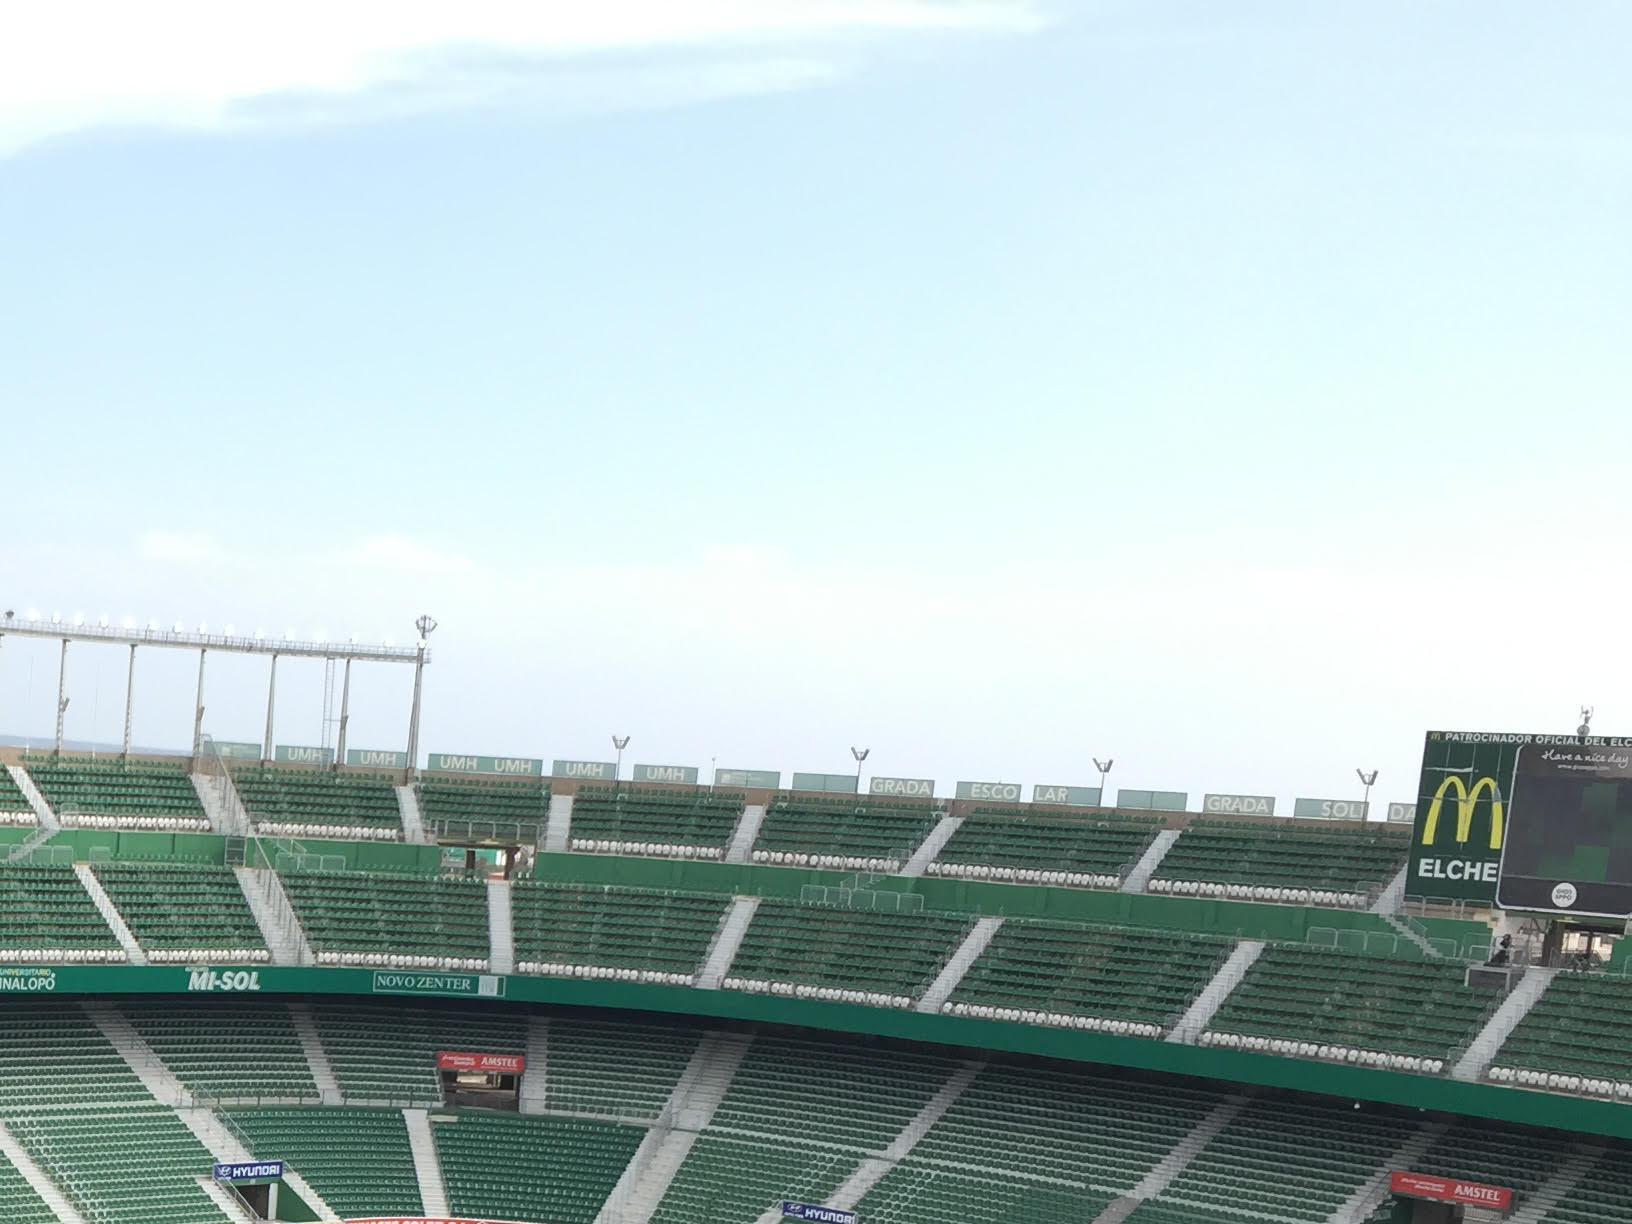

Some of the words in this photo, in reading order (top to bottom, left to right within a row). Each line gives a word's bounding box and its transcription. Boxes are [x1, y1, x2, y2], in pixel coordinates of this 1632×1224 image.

[1445, 732, 1532, 744] PATROCINADOR
[1535, 735, 1581, 746] OFICIAL
[1584, 736, 1607, 747] DEL
[360, 751, 397, 765] UMH
[440, 755, 477, 770] UMH
[495, 758, 532, 773] UMH
[566, 762, 604, 777] UMH
[646, 766, 685, 781] UMH
[872, 778, 931, 796] GRADA
[970, 784, 1018, 800] ESCO
[1034, 786, 1068, 801] LAR
[1207, 796, 1269, 814] GRADA
[1418, 858, 1499, 882] ELCHE
[0, 968, 51, 976] UNIVERSITARIO
[188, 970, 261, 991] MI-SOL
[377, 975, 415, 988] NOVO
[233, 1165, 280, 1178] HYUNDAI
[1454, 1184, 1500, 1201] AMSTEL
